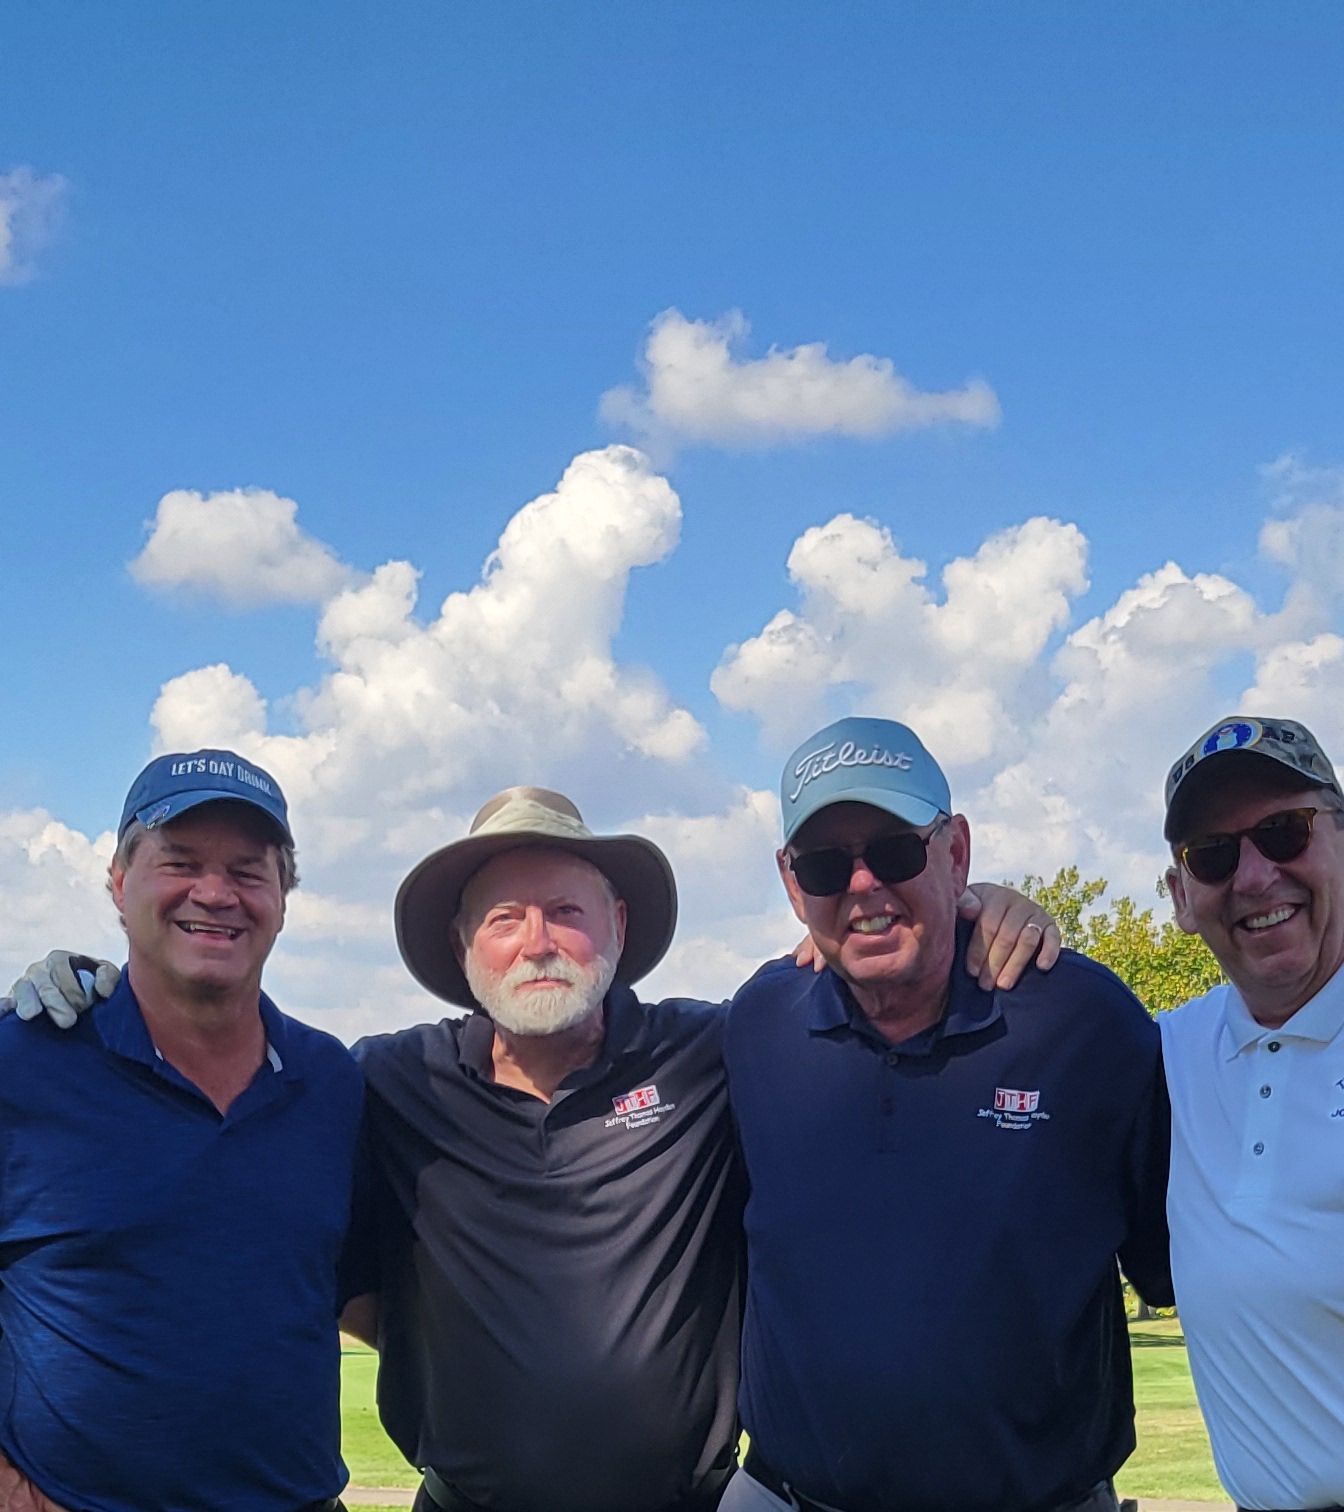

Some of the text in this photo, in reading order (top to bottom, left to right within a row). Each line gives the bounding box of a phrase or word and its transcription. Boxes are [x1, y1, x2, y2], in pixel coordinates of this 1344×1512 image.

[171, 758, 206, 777] LET'S
[208, 759, 235, 778] DAY
[789, 741, 914, 802] Titleist
[613, 1087, 657, 1114] JTHF
[995, 1089, 1038, 1111] JTHF
